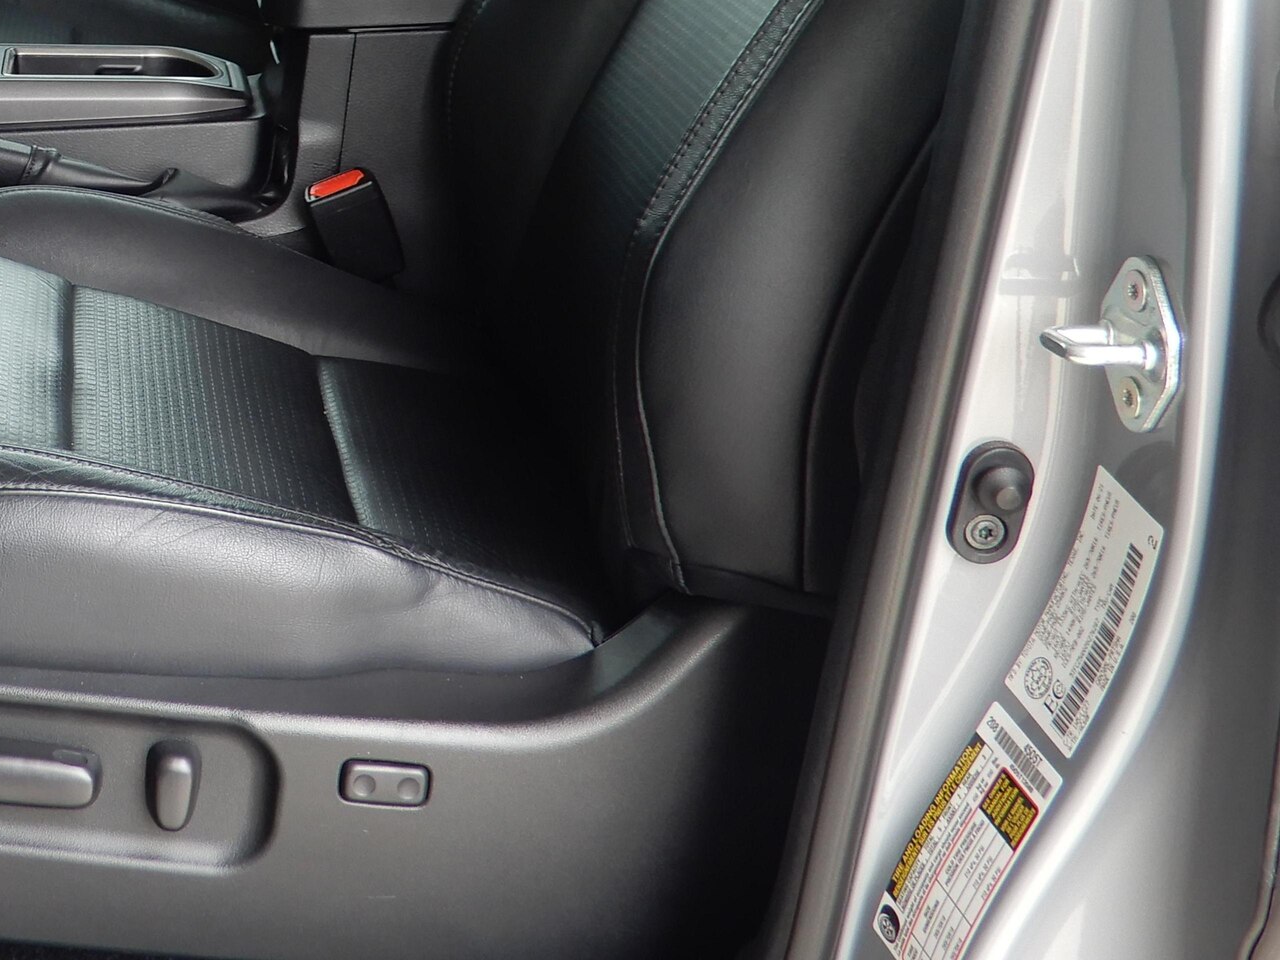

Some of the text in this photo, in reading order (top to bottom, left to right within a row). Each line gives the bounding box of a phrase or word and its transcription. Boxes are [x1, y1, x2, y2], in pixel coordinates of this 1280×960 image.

[891, 860, 905, 883] TIRE
[900, 840, 915, 863] AND
[911, 802, 936, 844] LOADING
[933, 740, 973, 808] INFORMATION
